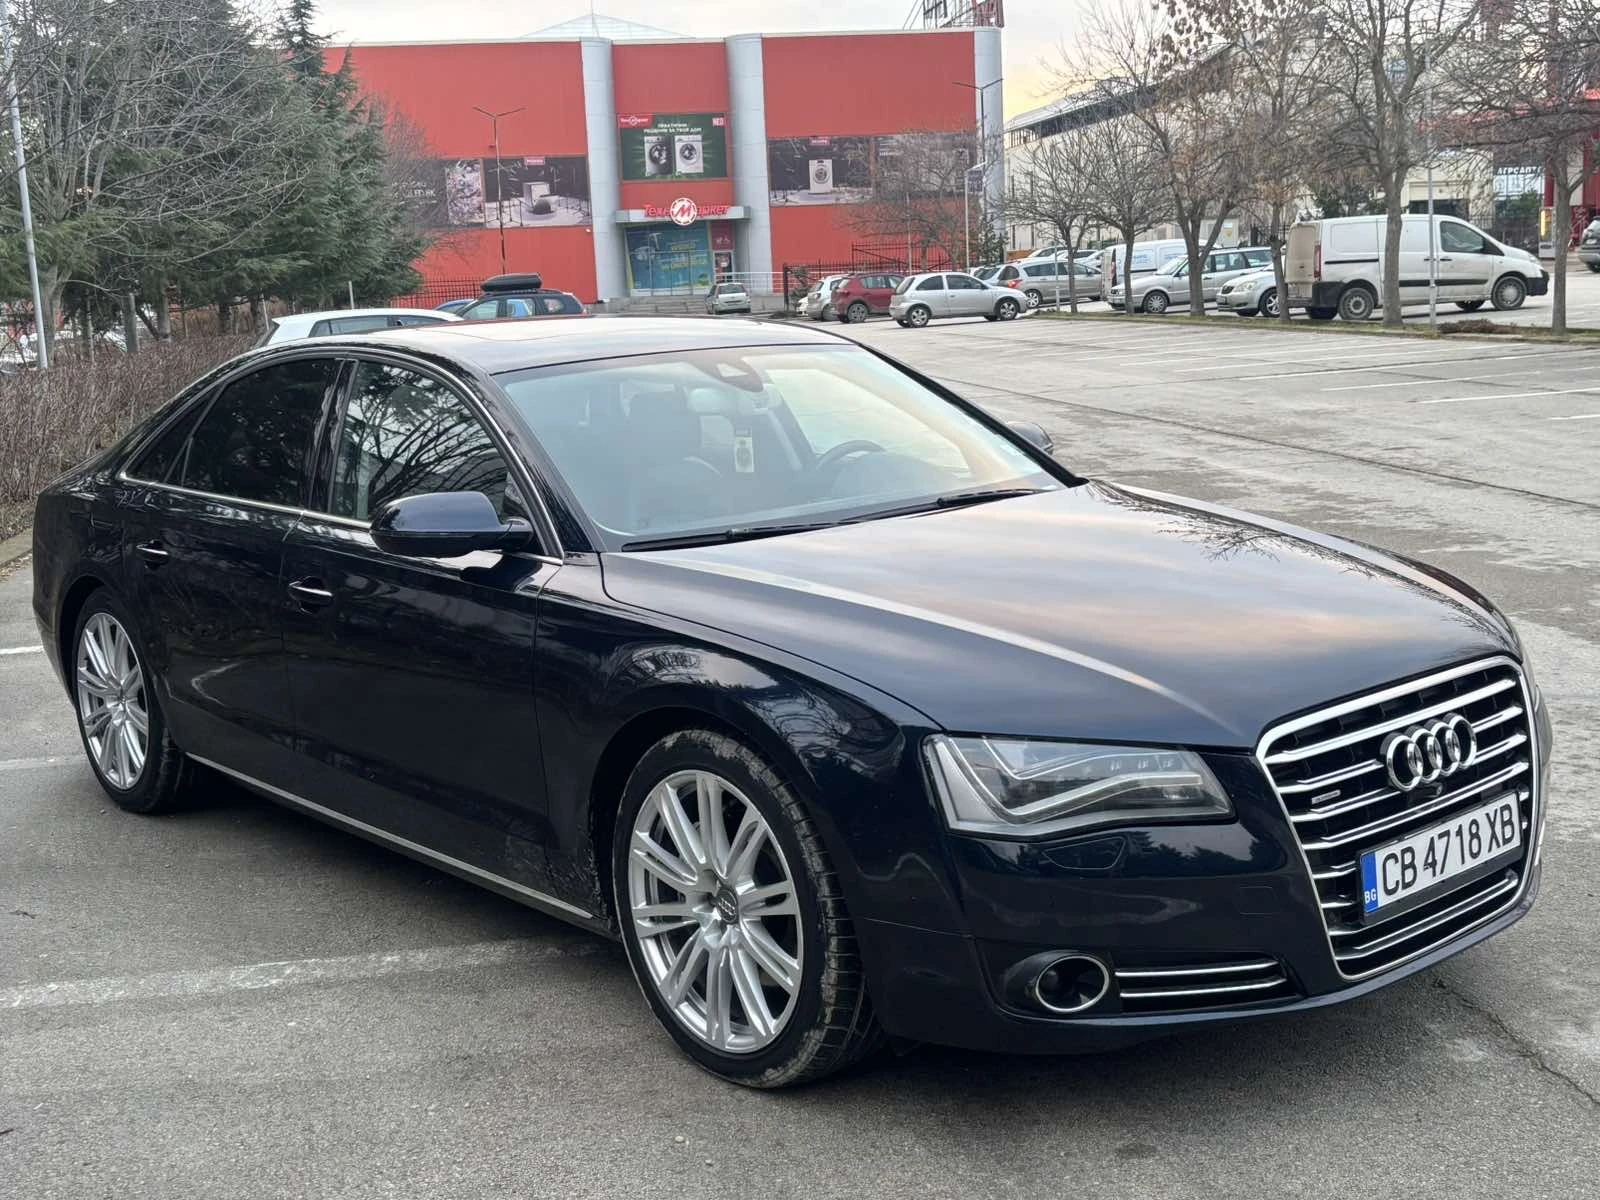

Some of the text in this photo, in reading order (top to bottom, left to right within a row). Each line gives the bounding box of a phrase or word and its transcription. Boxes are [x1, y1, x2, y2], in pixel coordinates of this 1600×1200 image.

[1382, 803, 1515, 896] CB 4718 XB
[1364, 888, 1377, 904] BG
